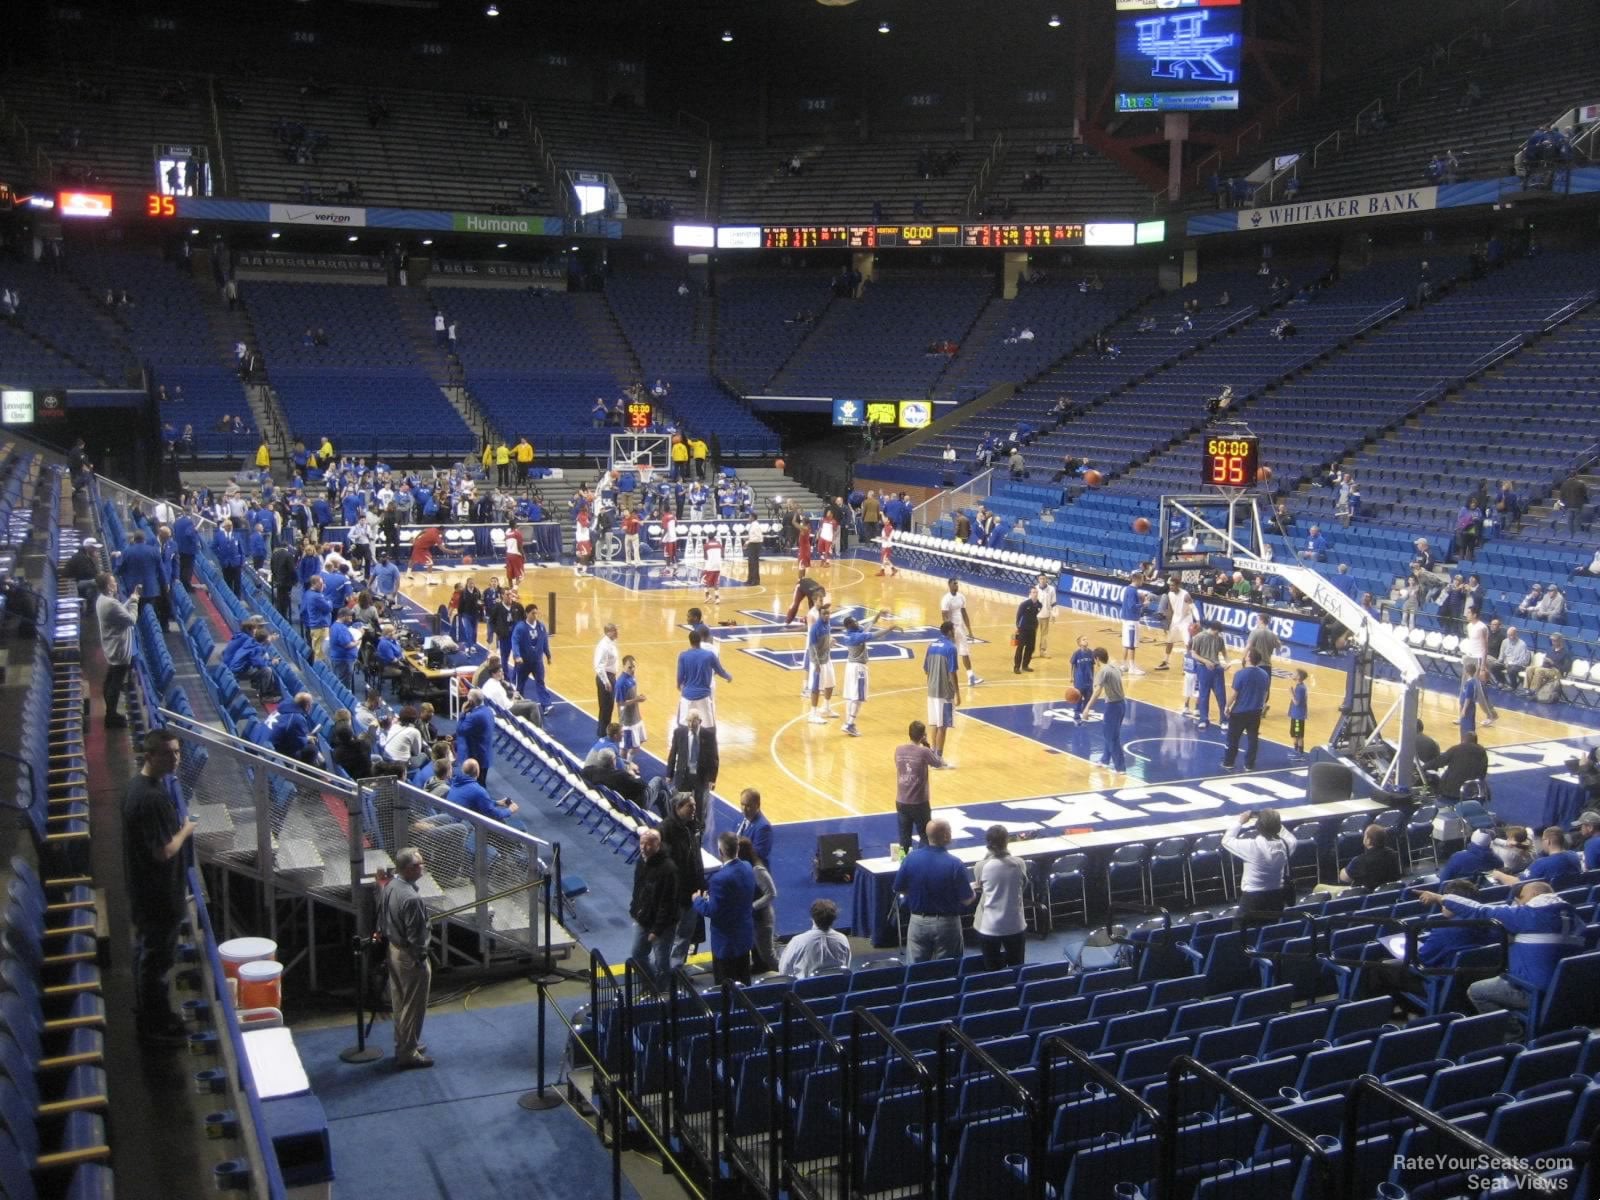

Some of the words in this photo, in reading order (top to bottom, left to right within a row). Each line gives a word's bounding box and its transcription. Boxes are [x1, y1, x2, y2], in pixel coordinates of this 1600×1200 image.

[149, 195, 175, 215] 35
[1269, 200, 1359, 224] WHITAKER
[1368, 192, 1420, 213] BANK
[315, 212, 350, 223] verizon
[467, 215, 528, 232] Humana
[903, 226, 932, 239] 60:00
[629, 404, 650, 413] 60:00
[632, 413, 647, 426] 35
[1209, 440, 1249, 456] 60:00
[1213, 456, 1243, 482] 35
[1202, 602, 1294, 639] WILDCTS
